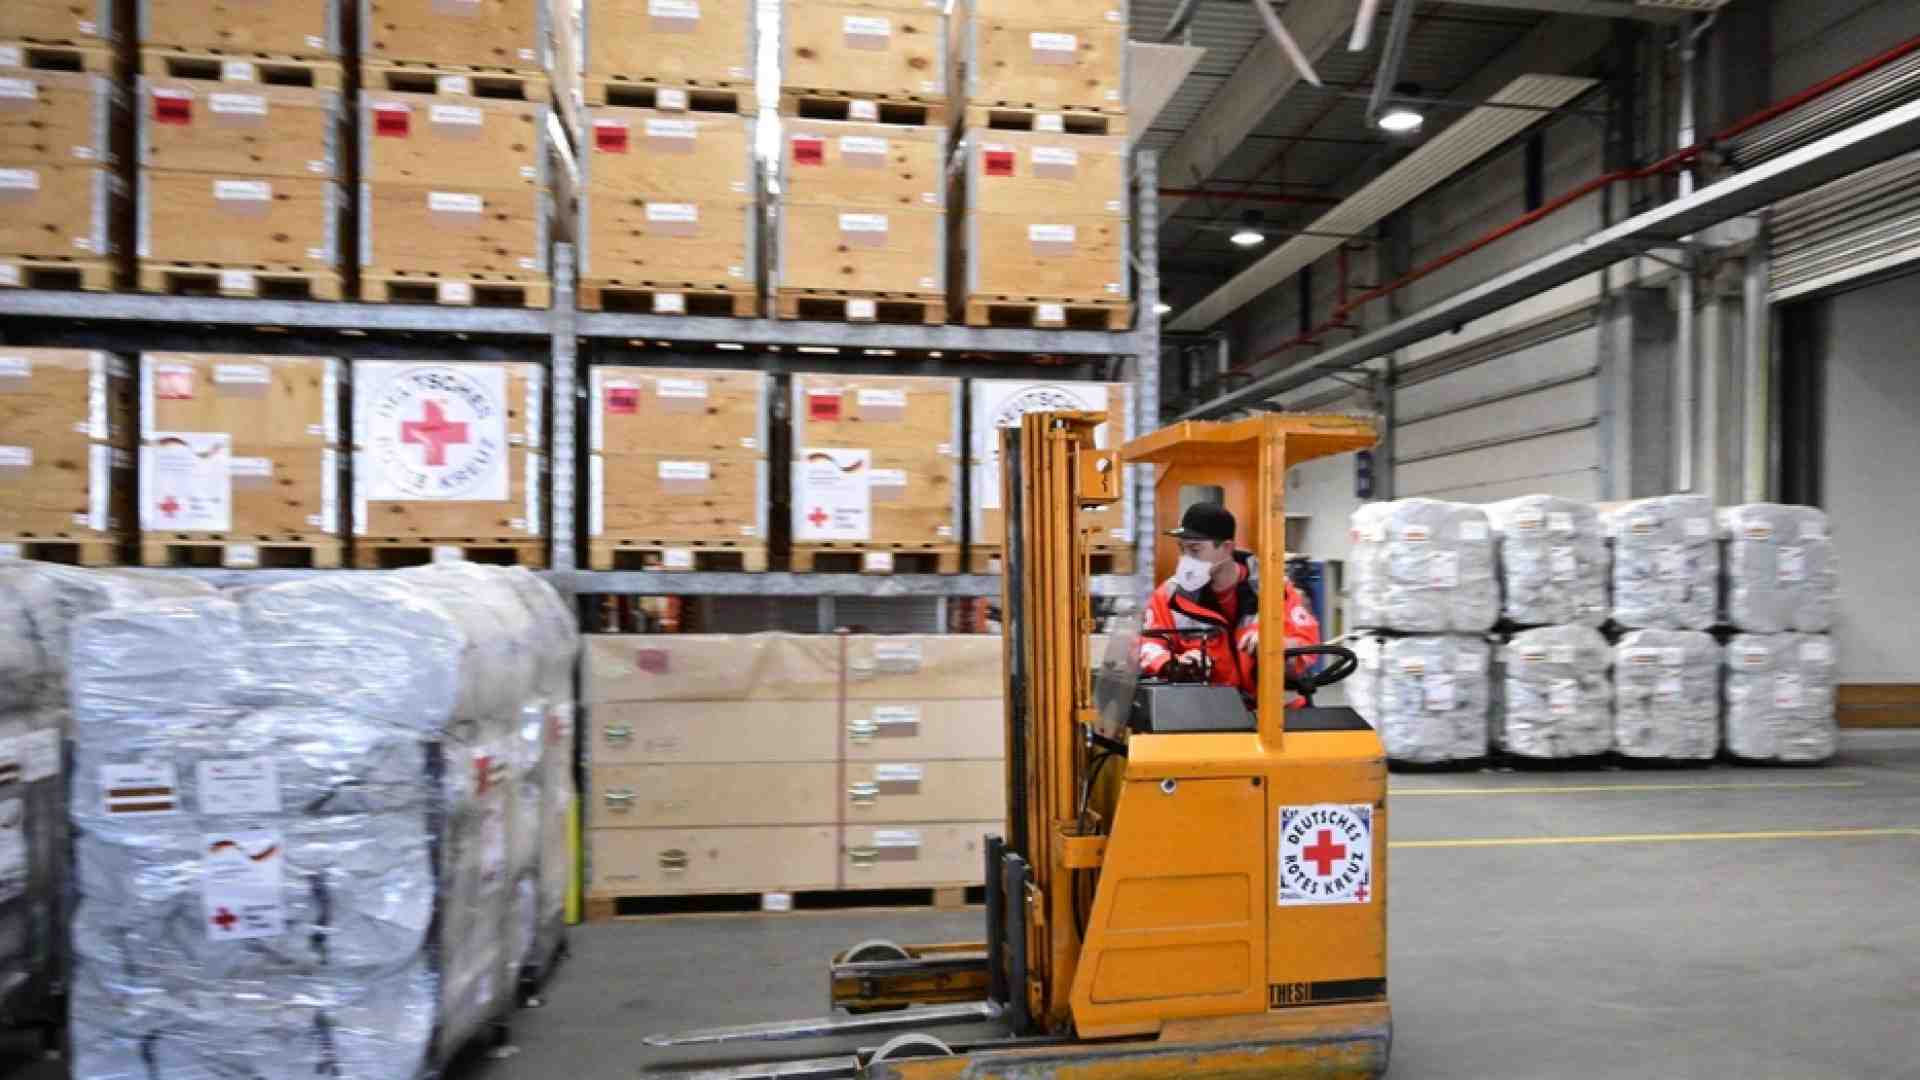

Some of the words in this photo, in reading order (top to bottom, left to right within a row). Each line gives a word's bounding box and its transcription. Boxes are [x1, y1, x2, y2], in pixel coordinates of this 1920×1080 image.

[1287, 809, 1362, 845] DEUTSCHES
[1284, 855, 1318, 894] ROTES
[1324, 852, 1363, 895] KREUZ
